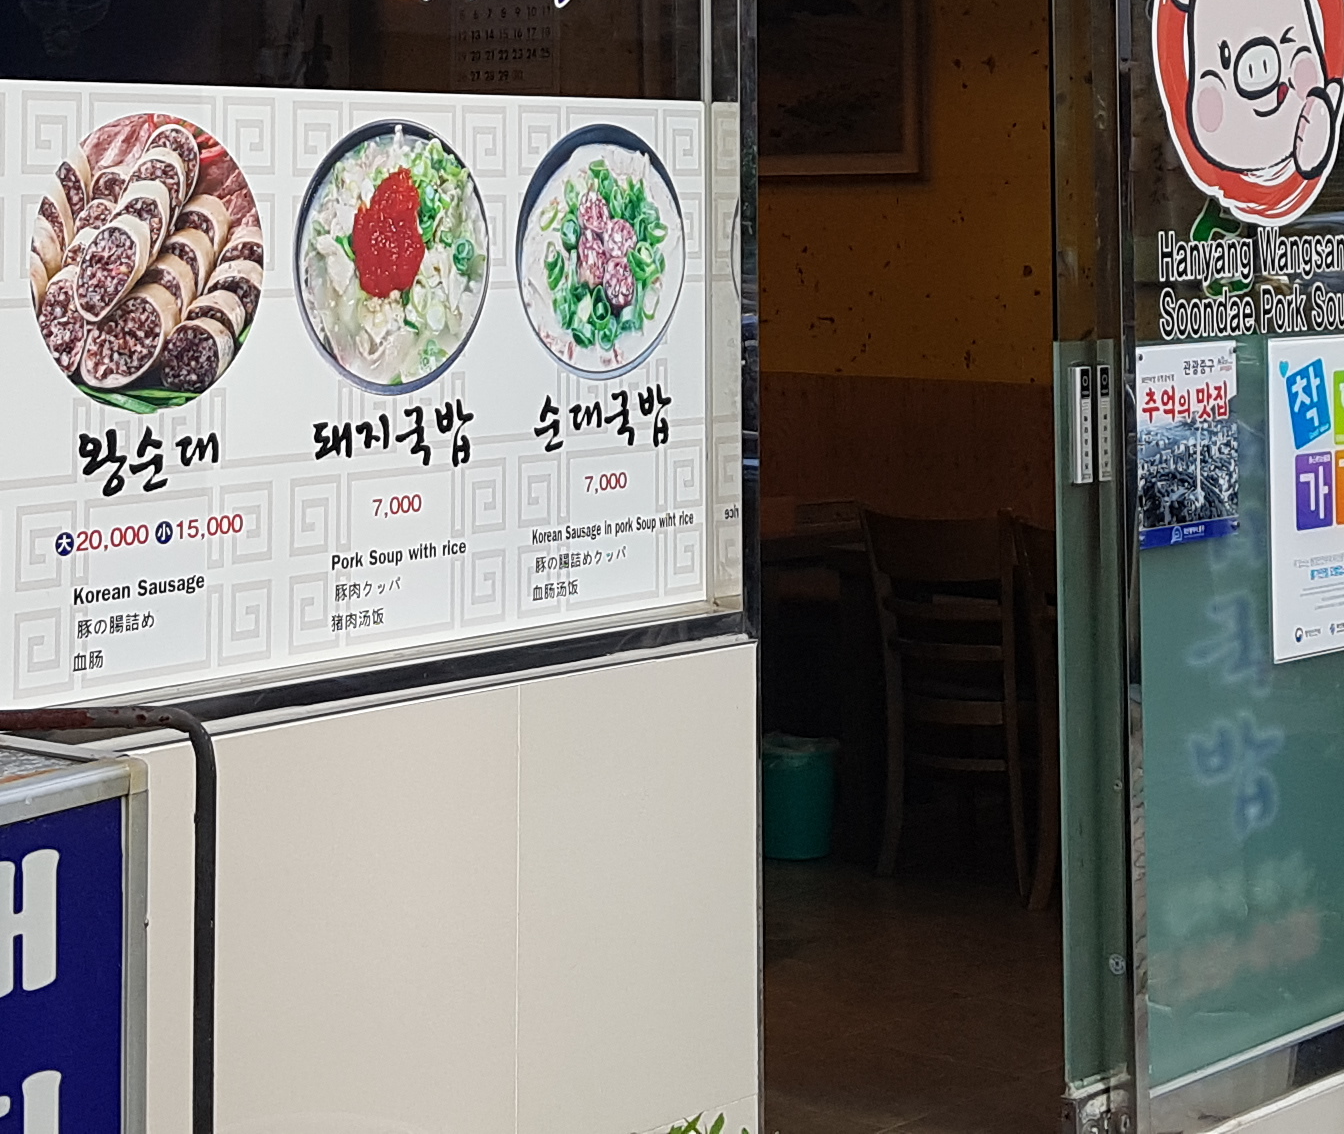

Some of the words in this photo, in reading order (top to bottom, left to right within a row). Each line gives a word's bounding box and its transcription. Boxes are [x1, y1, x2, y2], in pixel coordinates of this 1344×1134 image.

[1158, 230, 1253, 284] Hanyang
[1159, 286, 1255, 341] Soondae
[1260, 284, 1306, 334] Pork
[533, 383, 672, 453] 순대국밥
[1141, 384, 1192, 425] 추억의
[1195, 379, 1230, 420] 맛집
[312, 399, 475, 467] 돼지국밥
[78, 426, 219, 498] 왕순대
[584, 471, 628, 495] 7,000
[372, 494, 422, 518] 7,000
[75, 524, 150, 553] 20,000
[175, 513, 244, 541] 15,000
[531, 528, 563, 546] Korean
[566, 523, 602, 541] Sausage
[604, 519, 613, 535] in
[615, 517, 634, 537] pork
[636, 515, 657, 532] Soup
[679, 510, 694, 526] rice
[331, 551, 364, 571] Pork
[369, 549, 404, 566] Soup
[409, 541, 437, 560] with
[442, 539, 467, 557] rice
[73, 583, 132, 606] Korean
[137, 574, 205, 599] Sausage
[334, 576, 402, 602] 豚肉クッパ
[76, 613, 156, 640] 豚の腸詰め
[331, 608, 385, 633] 猪肉汤饭
[72, 651, 104, 673] 血肠
